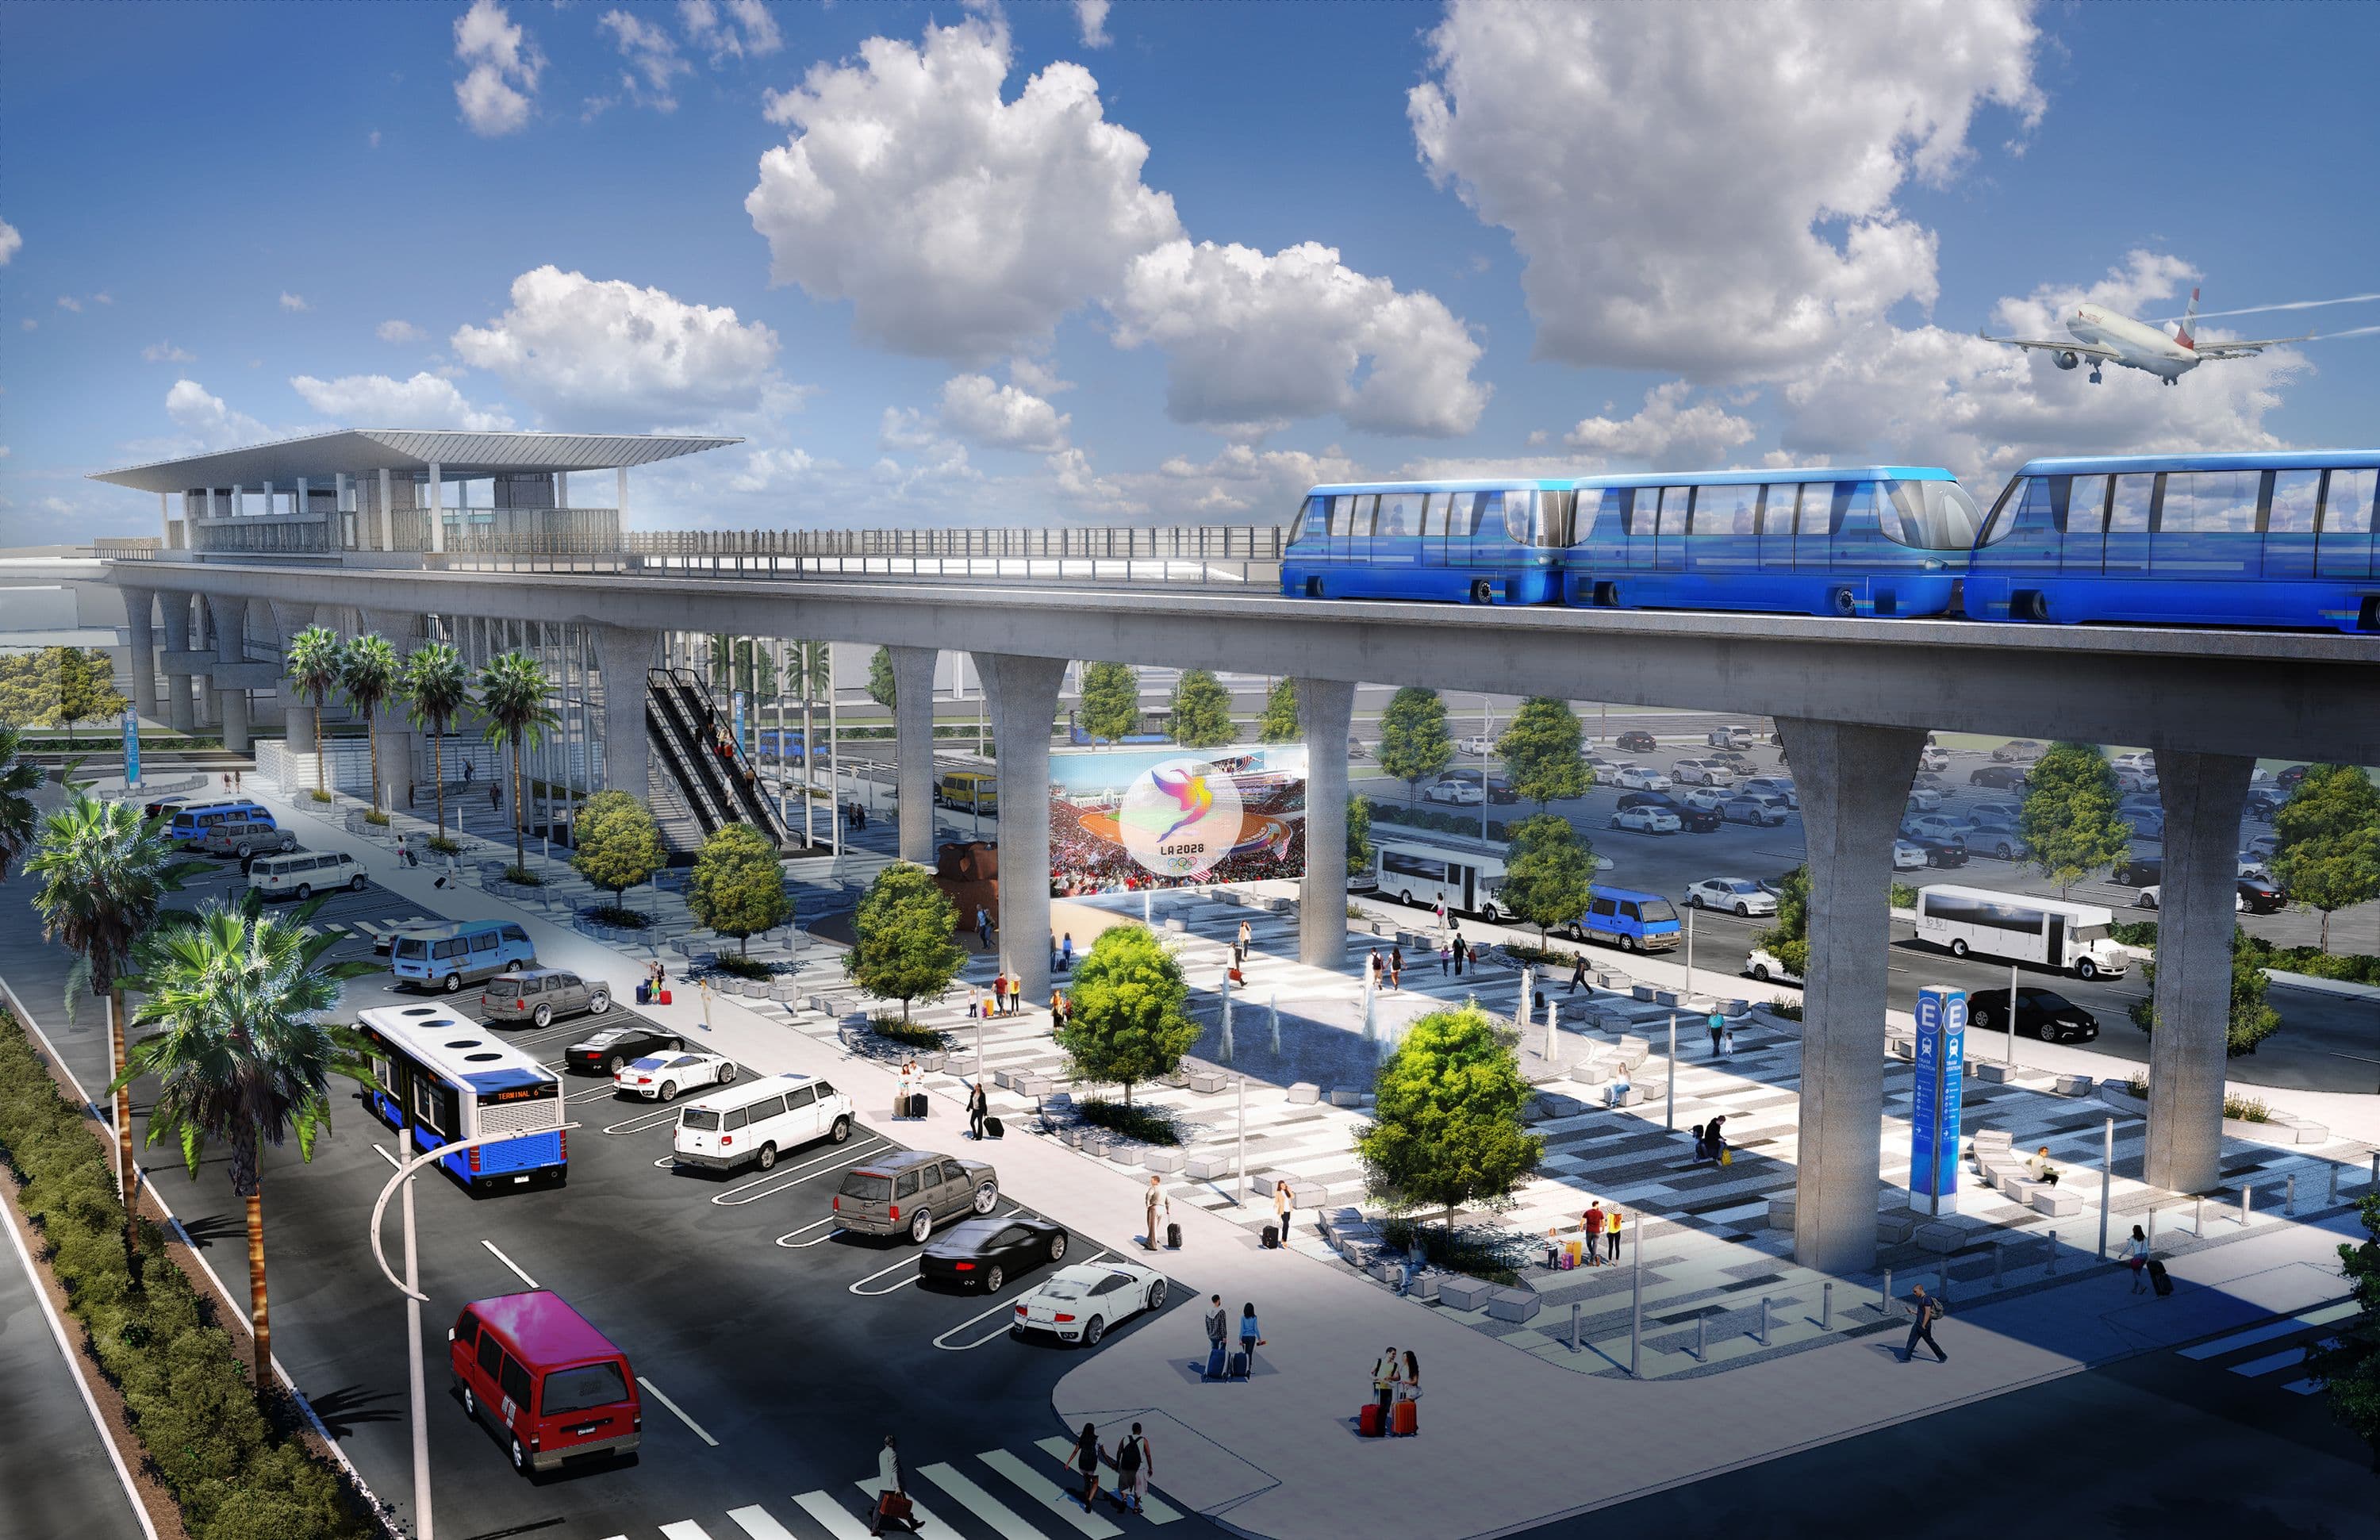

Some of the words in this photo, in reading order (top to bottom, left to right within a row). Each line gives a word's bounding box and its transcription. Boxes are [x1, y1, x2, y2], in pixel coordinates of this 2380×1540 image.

[127, 711, 135, 720] E
[1161, 846, 1174, 855] LA
[1177, 843, 1204, 854] 2028
[1921, 1004, 1936, 1027] E
[1949, 1004, 1962, 1028] E
[498, 1090, 530, 1100] TERMINAL
